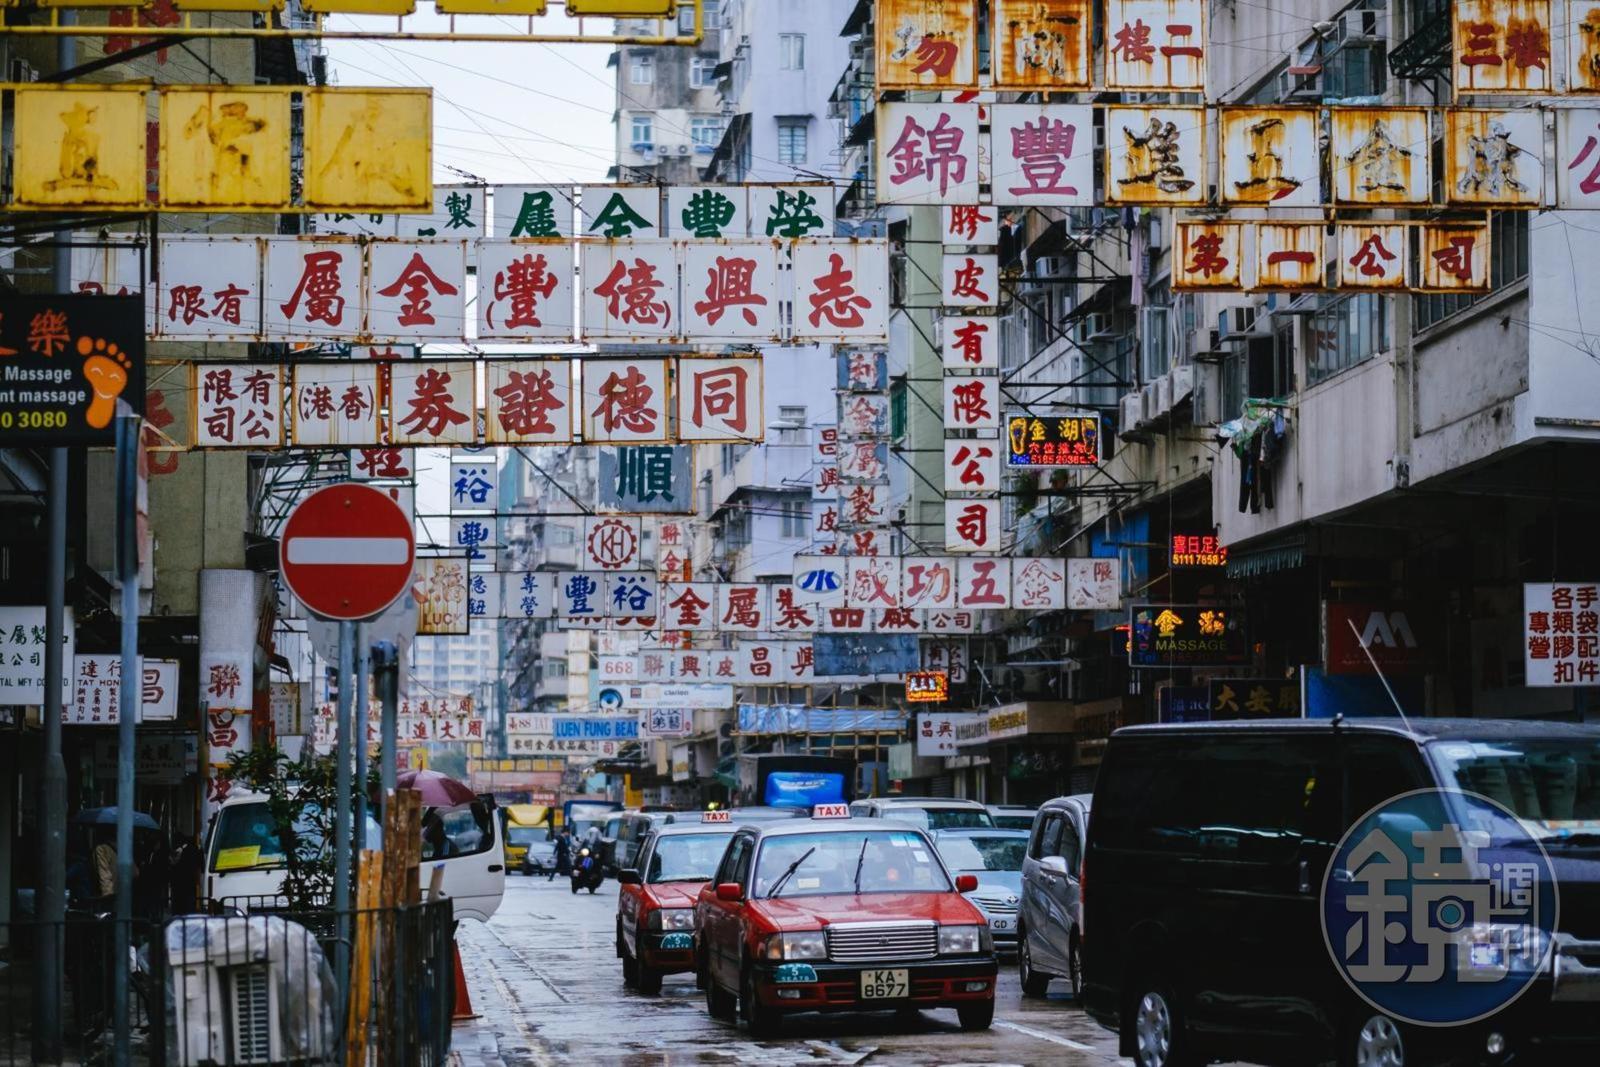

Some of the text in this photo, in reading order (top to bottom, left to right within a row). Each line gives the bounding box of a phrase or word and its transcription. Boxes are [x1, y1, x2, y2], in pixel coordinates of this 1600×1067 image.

[1186, 232, 1476, 281] 第一公司
[5, 366, 72, 383] Massage
[19, 390, 86, 405] massage
[18, 411, 67, 428] 3080
[931, 612, 971, 629] 公司
[1528, 611, 1550, 659] 專營
[1155, 640, 1228, 652] MASSAGE
[605, 661, 633, 674] 668
[556, 721, 581, 737] LUEN
[584, 721, 611, 737] FUNG
[705, 812, 729, 821] TAXI
[818, 806, 847, 816] TAXI
[791, 966, 799, 976] 5
[874, 972, 896, 983] KA
[864, 984, 906, 997] 8677
